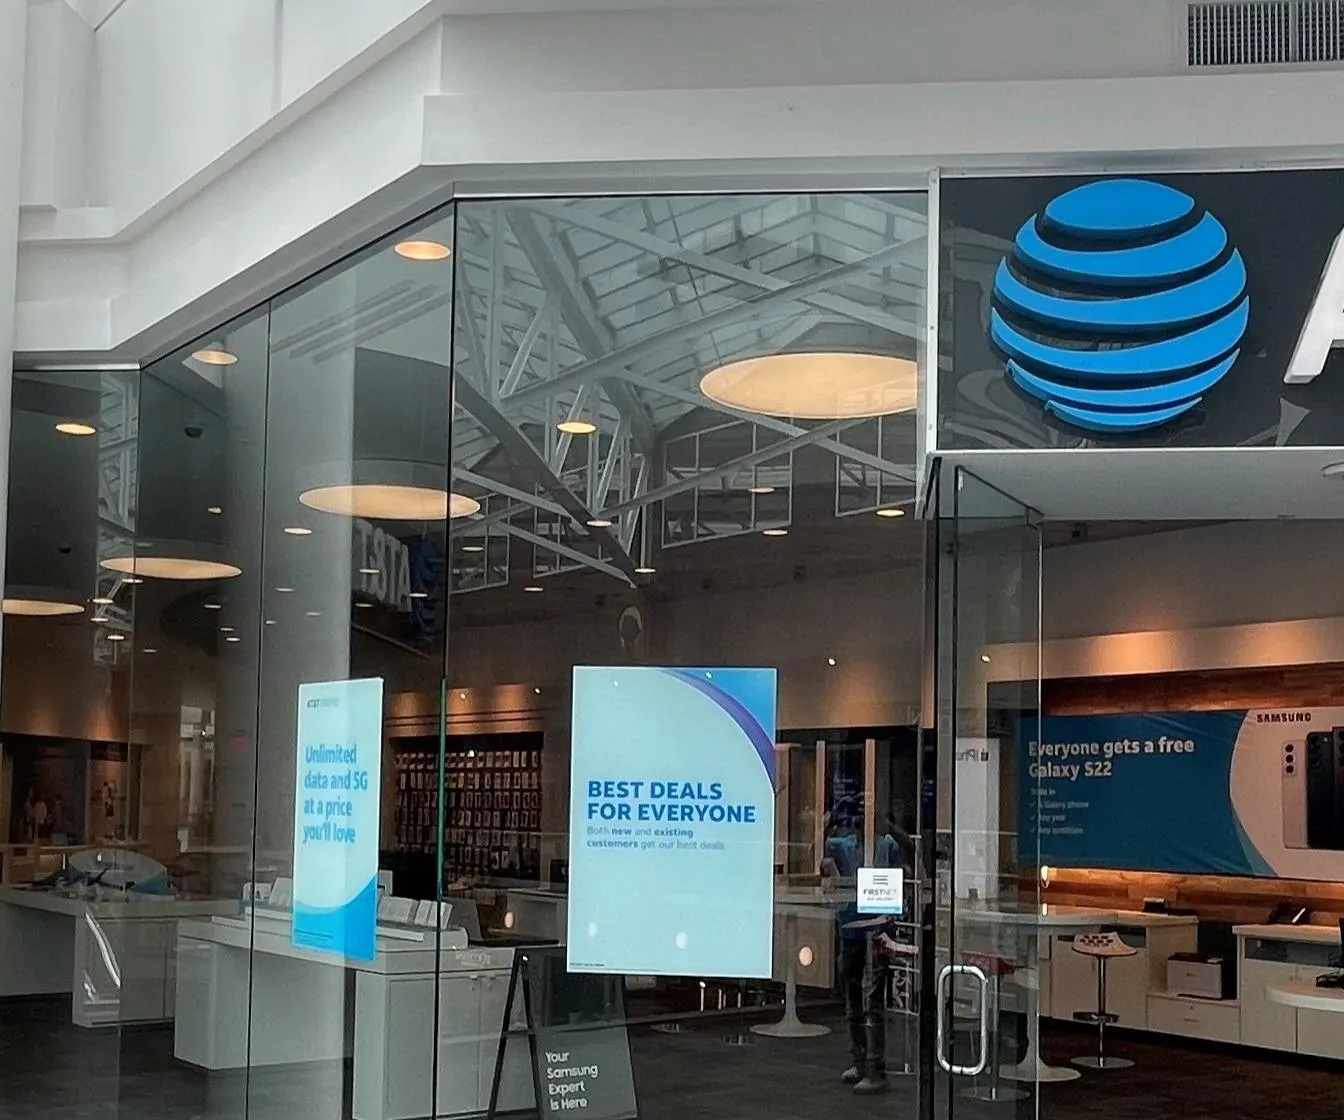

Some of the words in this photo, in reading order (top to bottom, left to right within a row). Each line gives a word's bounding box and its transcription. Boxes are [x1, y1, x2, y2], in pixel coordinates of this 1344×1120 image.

[1257, 712, 1311, 723] SAMSUNG
[306, 744, 357, 764] Unlimited
[1029, 741, 1100, 759] Everyone
[1104, 738, 1140, 758] gets
[1144, 741, 1154, 753] a
[1158, 736, 1195, 753] free
[305, 769, 329, 789] data
[331, 770, 351, 790] and
[353, 772, 368, 790] 5G
[1029, 761, 1080, 781] Galaxy
[1084, 761, 1112, 776] S22
[588, 781, 644, 798] BEST
[650, 782, 722, 800] DEALS
[304, 799, 315, 815] at
[317, 803, 323, 815] a
[326, 797, 353, 820] price
[588, 803, 632, 820] FOR
[638, 804, 756, 823] EVERYONE
[303, 821, 331, 844] you'll
[333, 823, 355, 843] love
[634, 827, 652, 836] and
[654, 828, 694, 839] existing
[587, 839, 638, 848] customers
[640, 841, 657, 851] get
[545, 1052, 570, 1063] Your
[547, 1065, 598, 1079] Samsung
[549, 1080, 585, 1097] Expert
